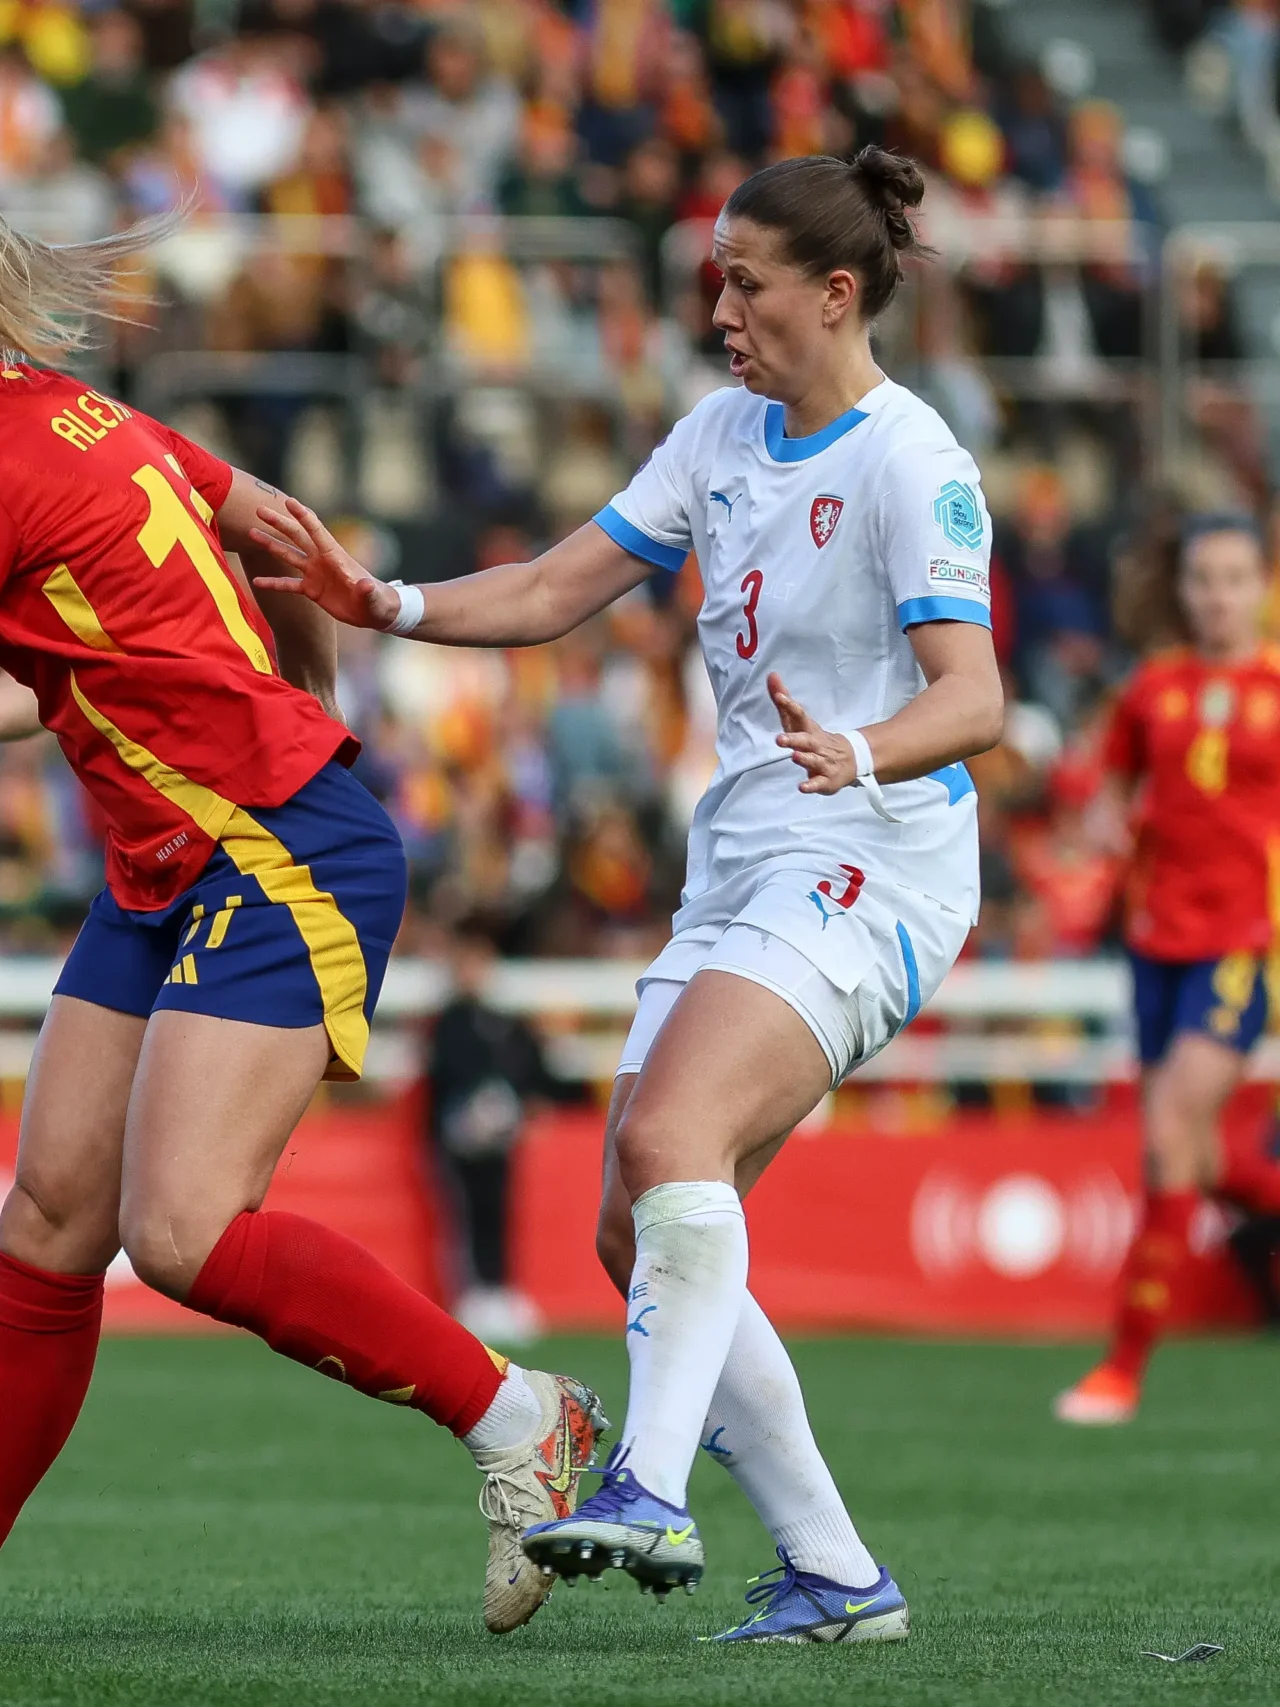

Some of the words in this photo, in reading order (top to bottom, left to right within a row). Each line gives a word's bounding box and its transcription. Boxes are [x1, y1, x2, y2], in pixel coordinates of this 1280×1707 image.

[50, 388, 133, 452] ALEX
[930, 558, 950, 567] UEFA
[930, 566, 989, 588] FOUNDATIO
[736, 569, 764, 660] 3
[155, 831, 189, 863] HEAT.RDY
[816, 863, 866, 910] 3
